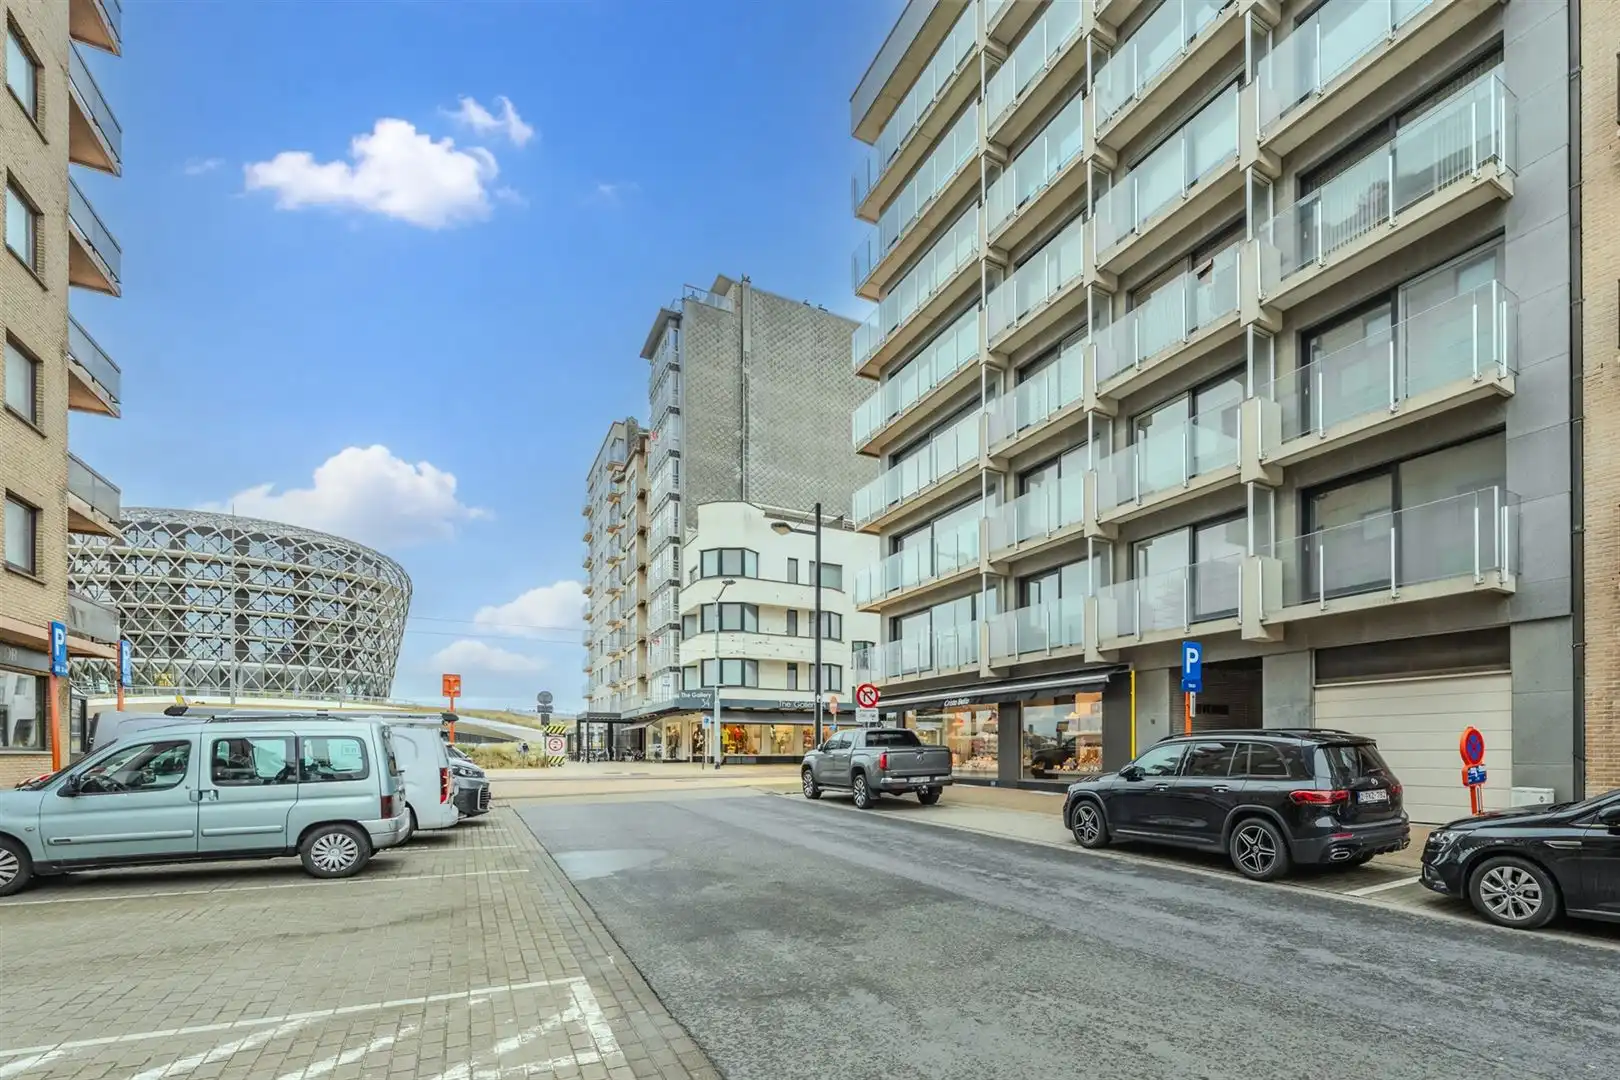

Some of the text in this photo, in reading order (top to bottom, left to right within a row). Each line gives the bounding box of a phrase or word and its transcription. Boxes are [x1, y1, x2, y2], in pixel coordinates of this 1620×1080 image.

[55, 628, 65, 656] P
[1186, 648, 1199, 673] P
[780, 700, 793, 708] The
